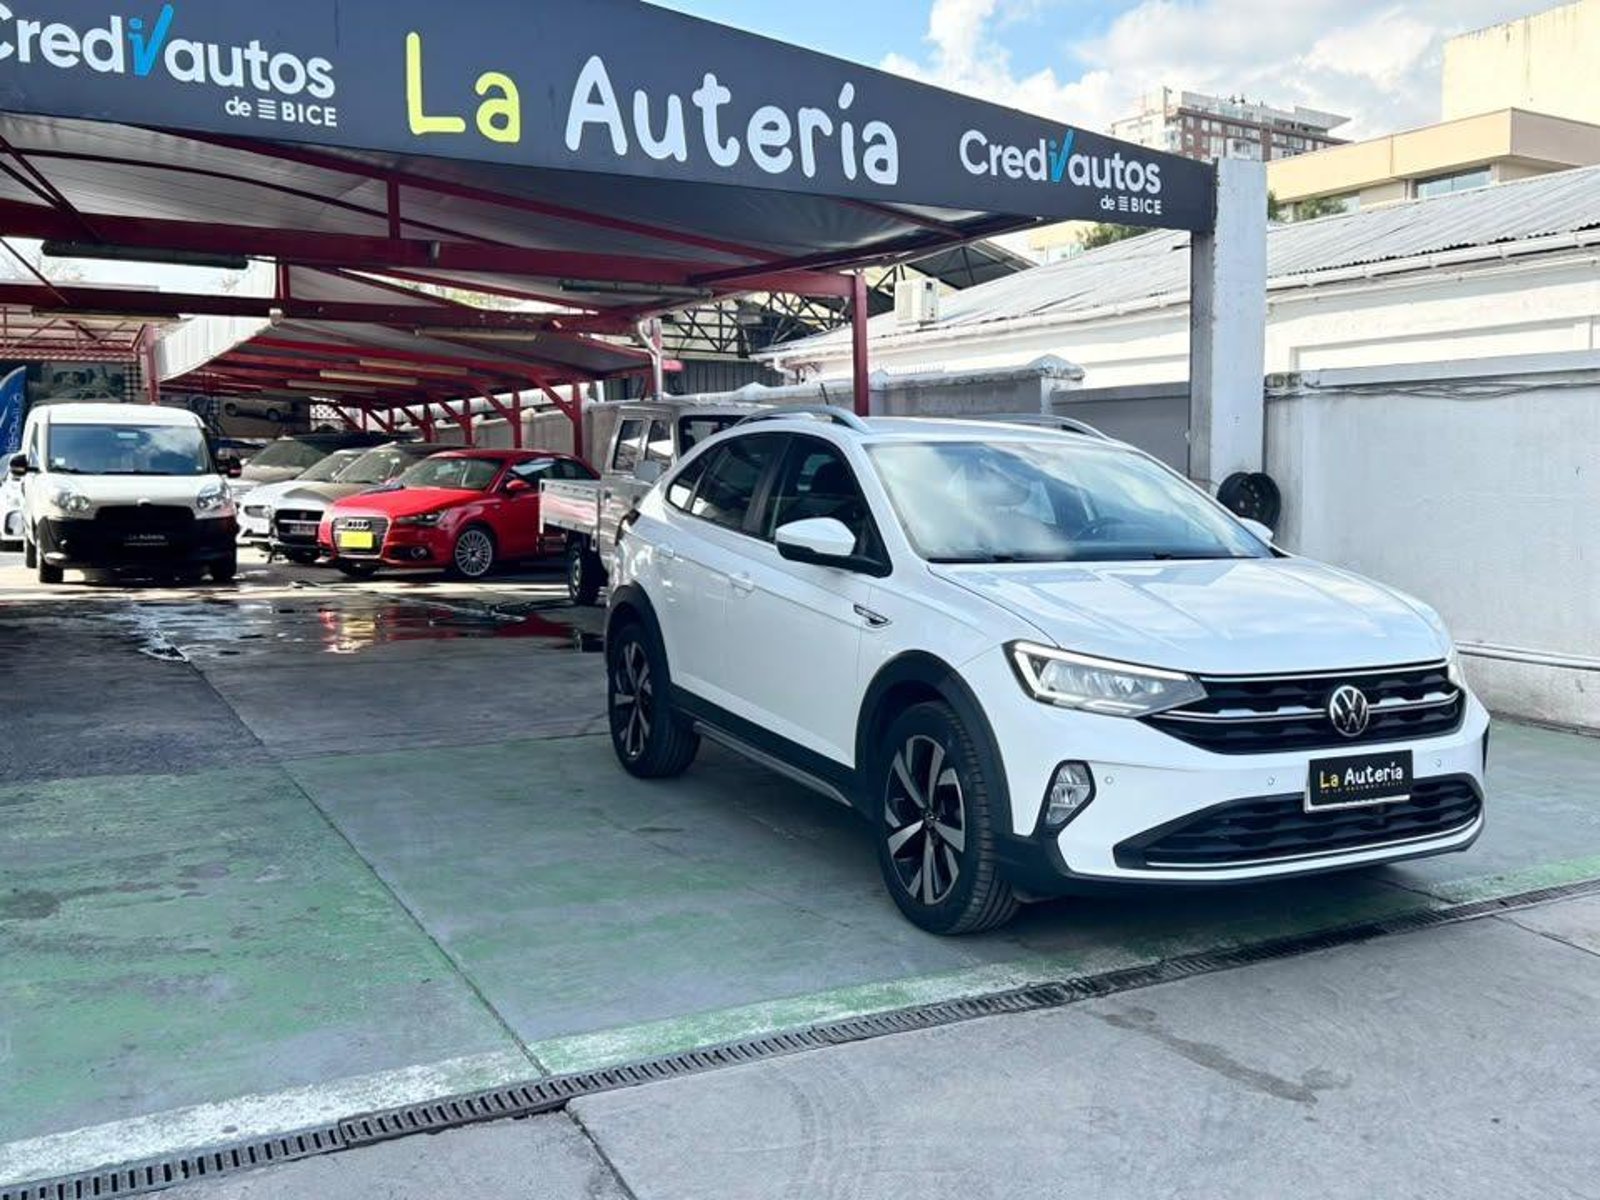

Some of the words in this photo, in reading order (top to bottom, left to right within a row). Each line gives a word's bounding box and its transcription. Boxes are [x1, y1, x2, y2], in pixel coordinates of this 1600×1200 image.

[225, 96, 252, 117] de
[281, 101, 337, 127] BICE
[406, 32, 520, 143] La
[565, 55, 898, 185] Autería
[1100, 195, 1116, 210] de
[1131, 199, 1163, 214] BICE
[1320, 770, 1339, 788] La
[1344, 761, 1403, 786] Autería
